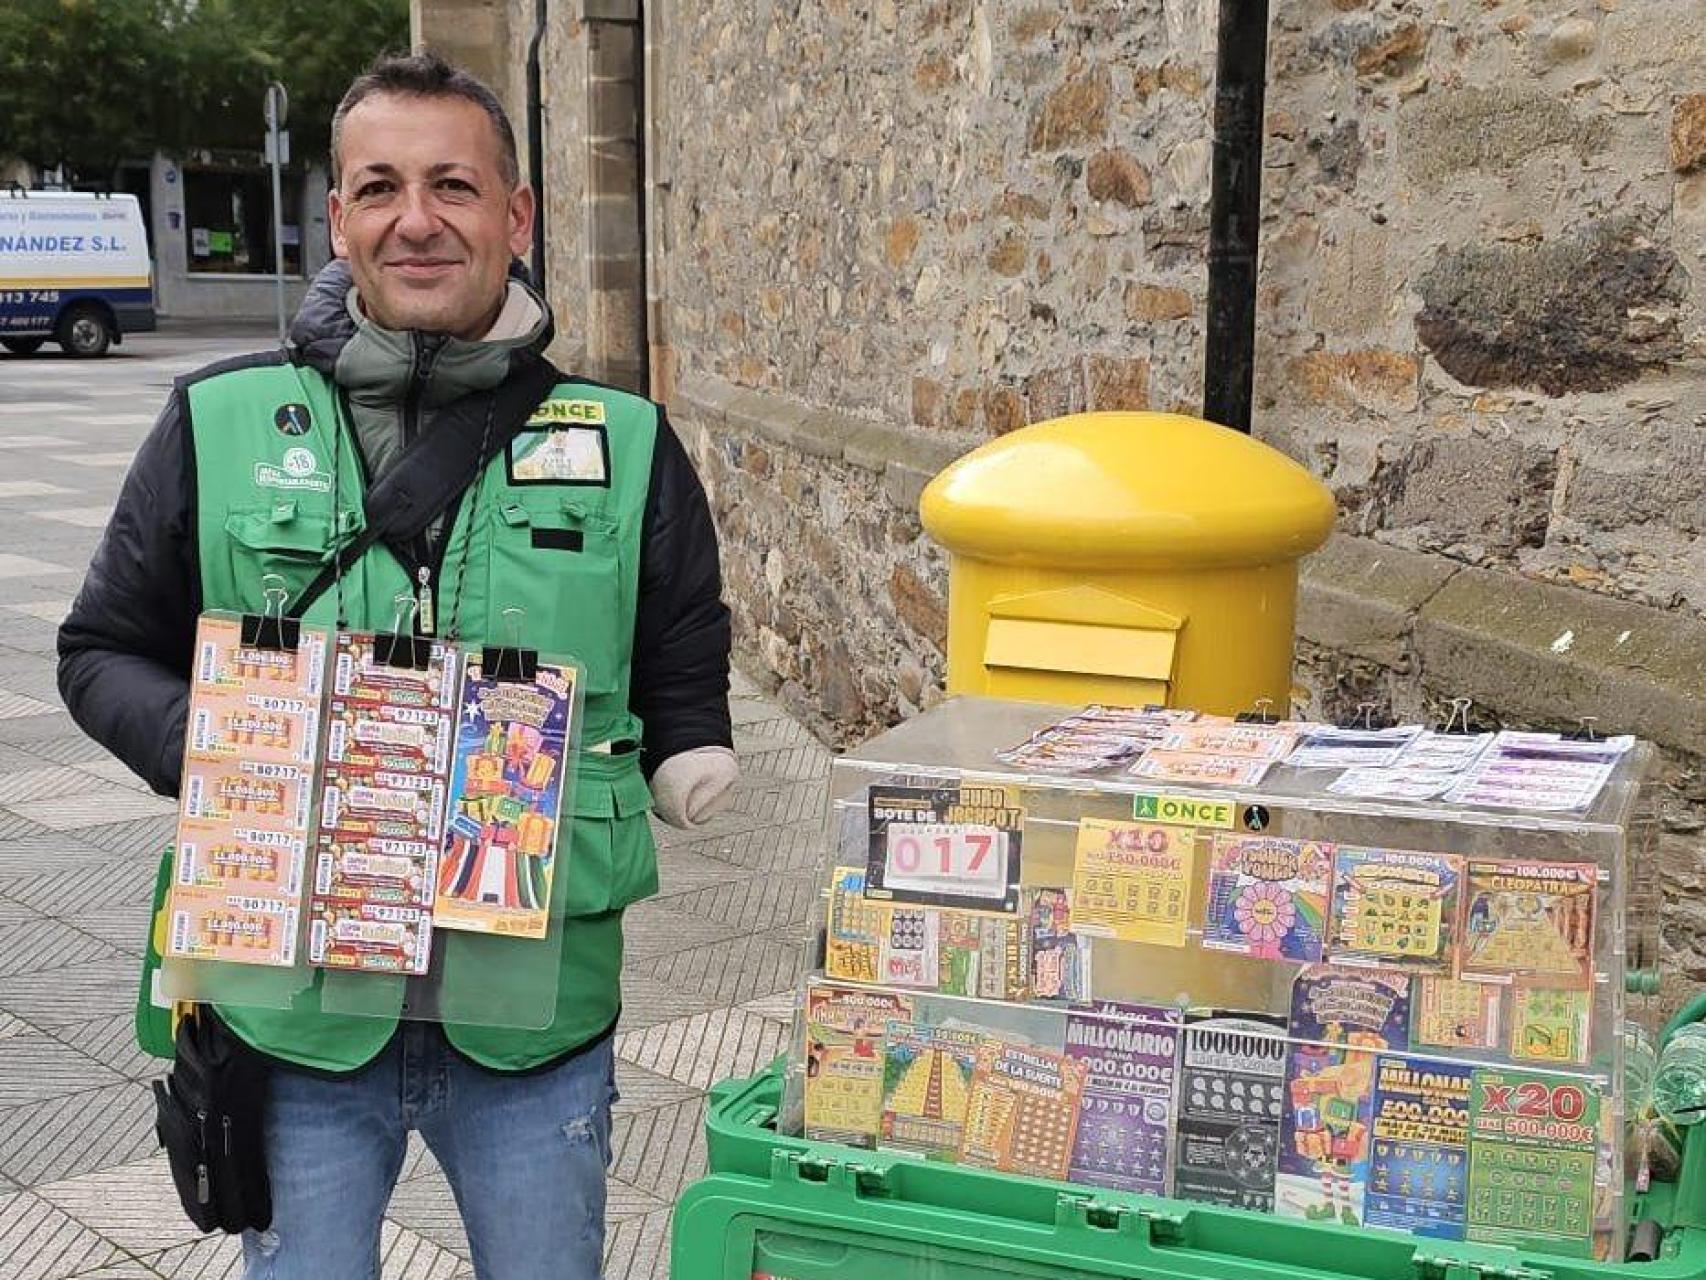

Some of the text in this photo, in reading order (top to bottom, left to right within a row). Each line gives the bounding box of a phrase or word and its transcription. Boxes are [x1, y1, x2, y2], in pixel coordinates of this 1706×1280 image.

[91, 235, 126, 252] S.L.
[263, 699, 304, 713] 80717
[257, 765, 298, 779] 80717
[873, 808, 913, 820] BOTE
[917, 810, 937, 822] DE
[1162, 802, 1228, 822] ONCE
[1516, 866, 1577, 880] 100.000€
[1067, 1023, 1175, 1057] MILLONARIO
[1504, 1117, 1594, 1143] 500.000€
